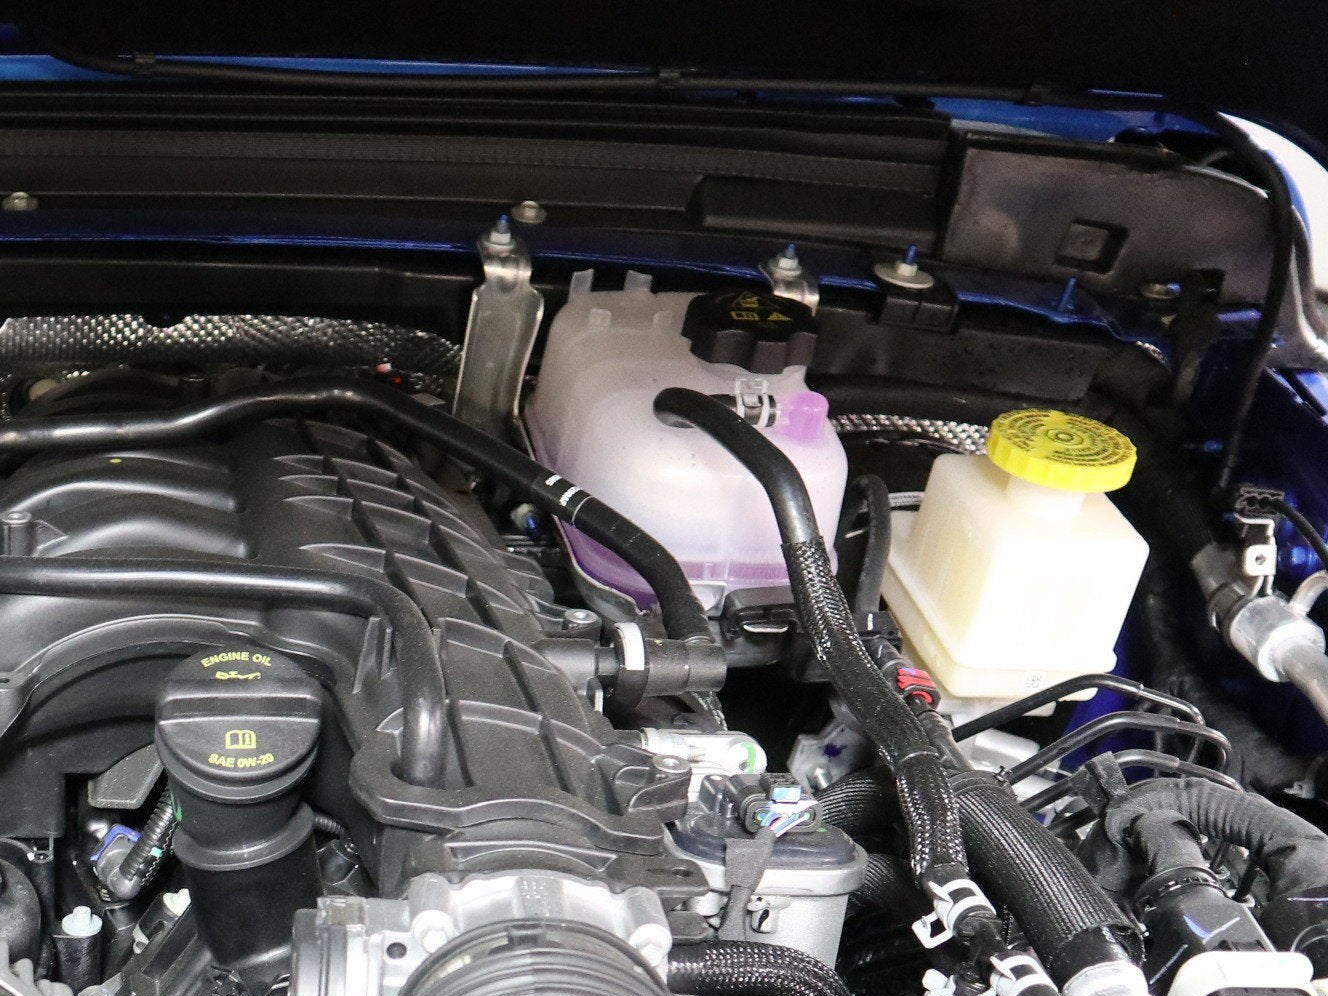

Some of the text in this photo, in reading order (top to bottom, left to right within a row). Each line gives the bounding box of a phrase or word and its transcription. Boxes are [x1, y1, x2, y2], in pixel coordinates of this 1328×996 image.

[200, 651, 273, 668] ENGINE OIL
[208, 752, 275, 768] SAE 0W-20
